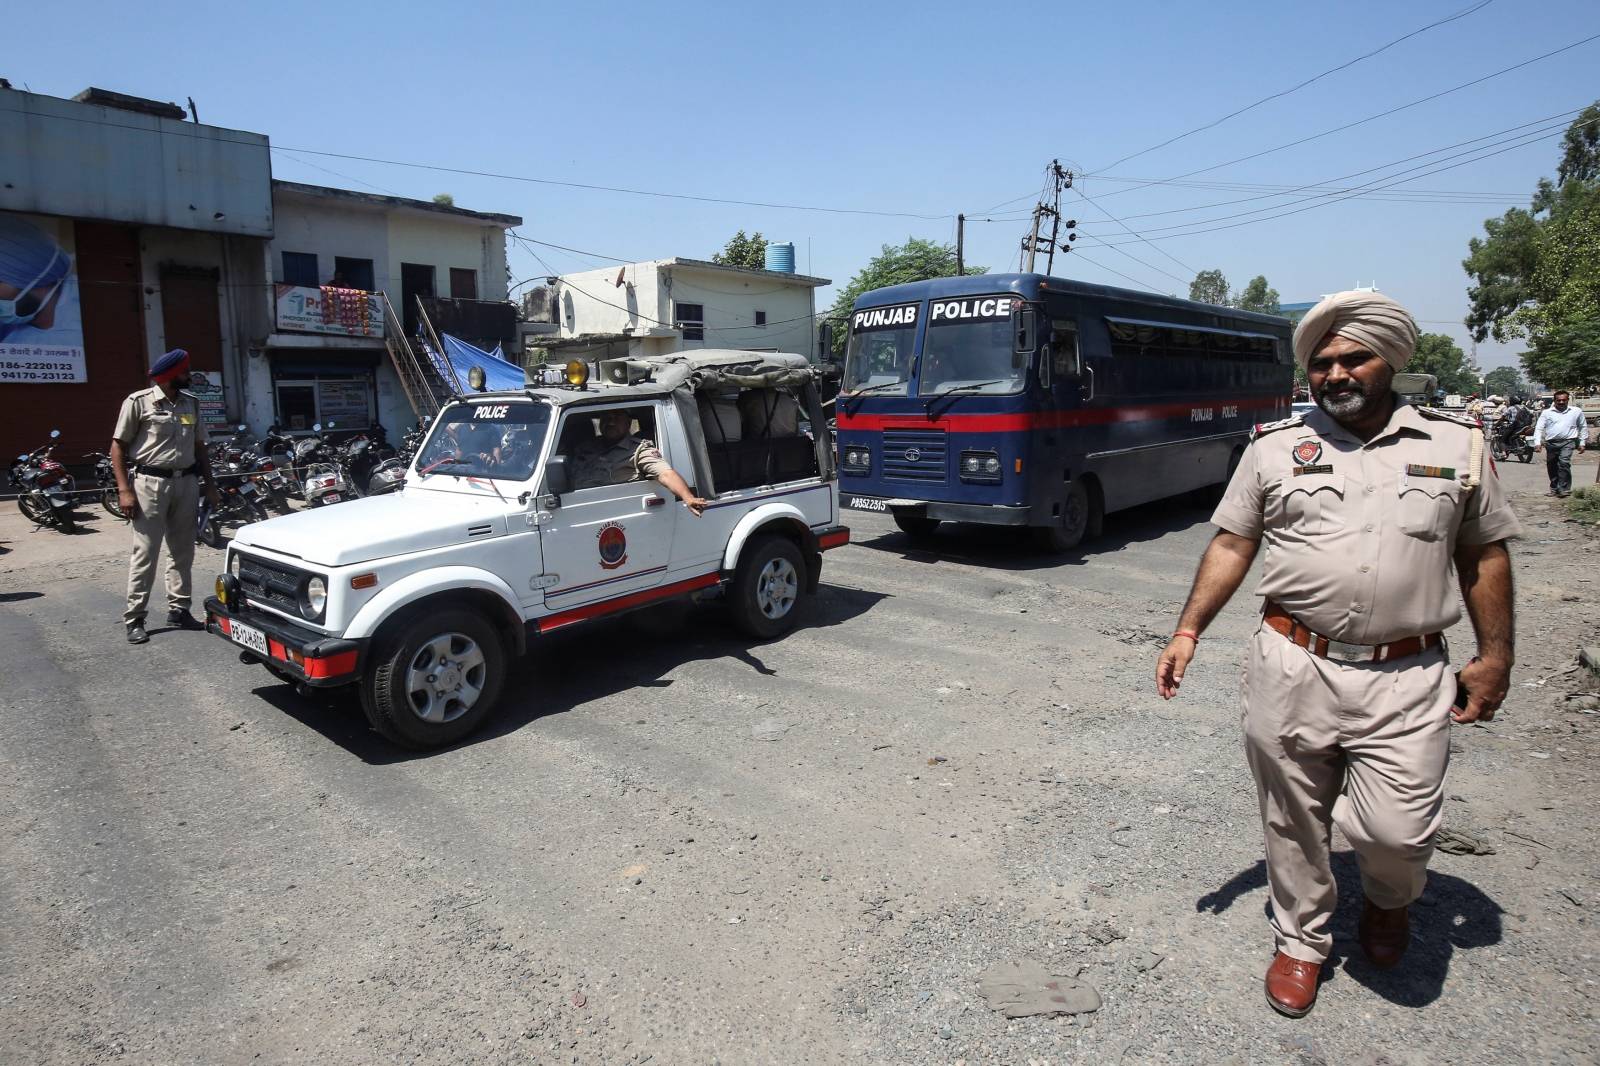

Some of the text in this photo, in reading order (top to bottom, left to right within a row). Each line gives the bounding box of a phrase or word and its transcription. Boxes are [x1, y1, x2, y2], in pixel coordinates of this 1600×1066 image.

[855, 306, 916, 329] PUNJAB
[932, 299, 1012, 320] POLICE
[1, 371, 75, 380] 94170-23123
[473, 405, 510, 419] POLICE
[1191, 405, 1238, 422] PUNJAB POLICE
